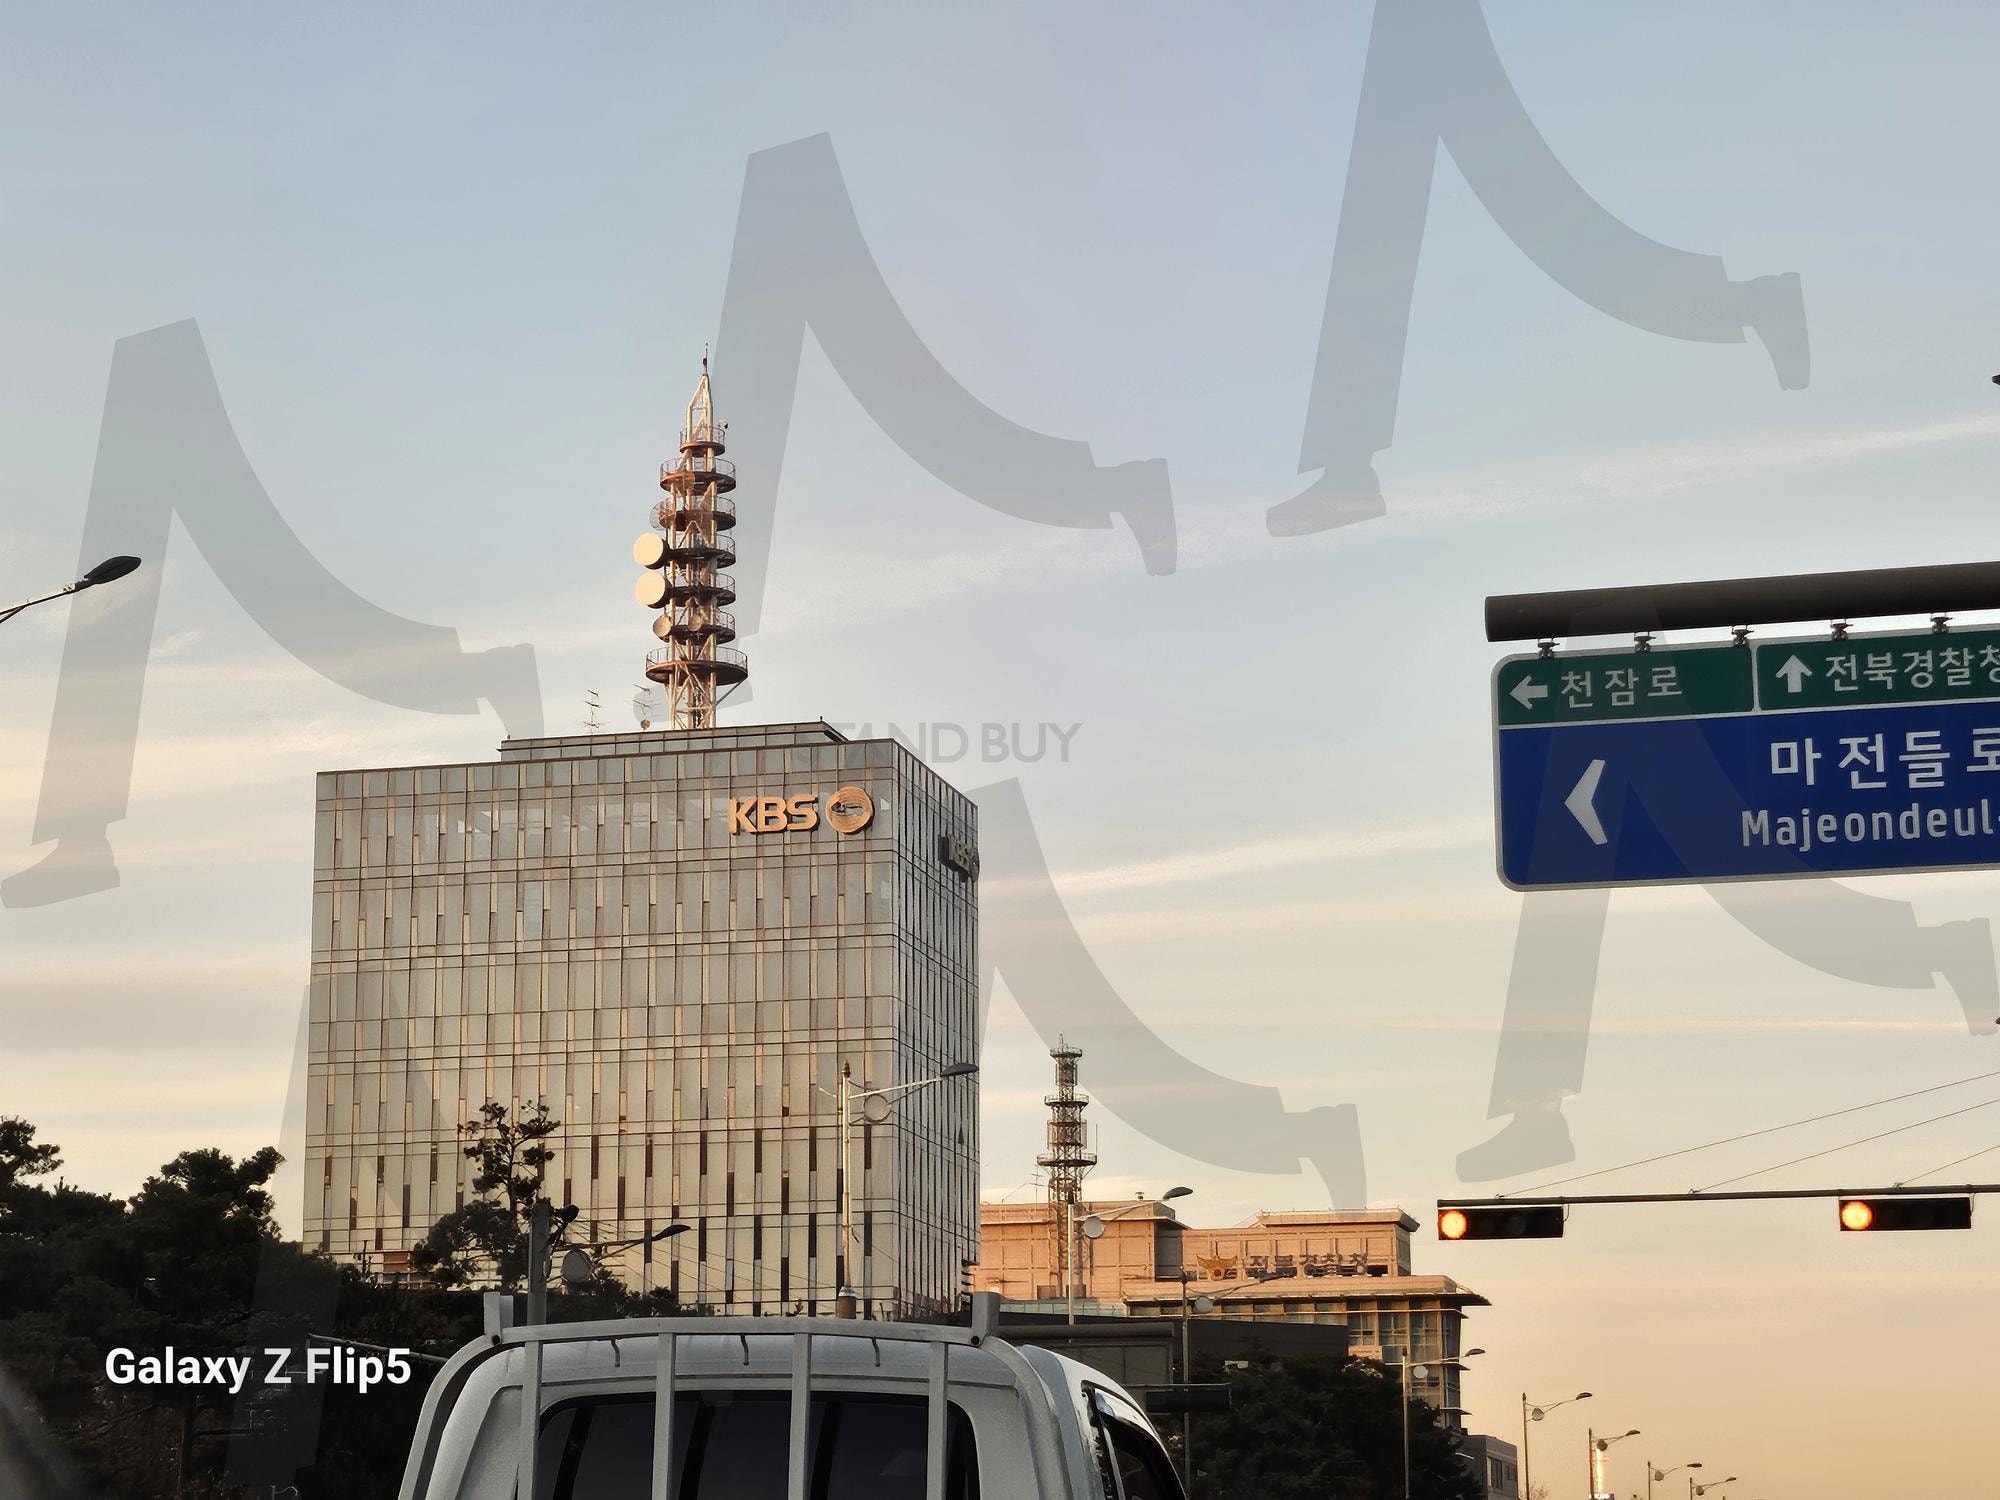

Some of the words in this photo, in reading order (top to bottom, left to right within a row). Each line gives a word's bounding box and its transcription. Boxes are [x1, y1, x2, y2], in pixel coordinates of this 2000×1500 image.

[1560, 665, 1683, 709] 천잠로
[728, 793, 820, 836] KBS
[1741, 798, 2000, 852] Majeondeul
